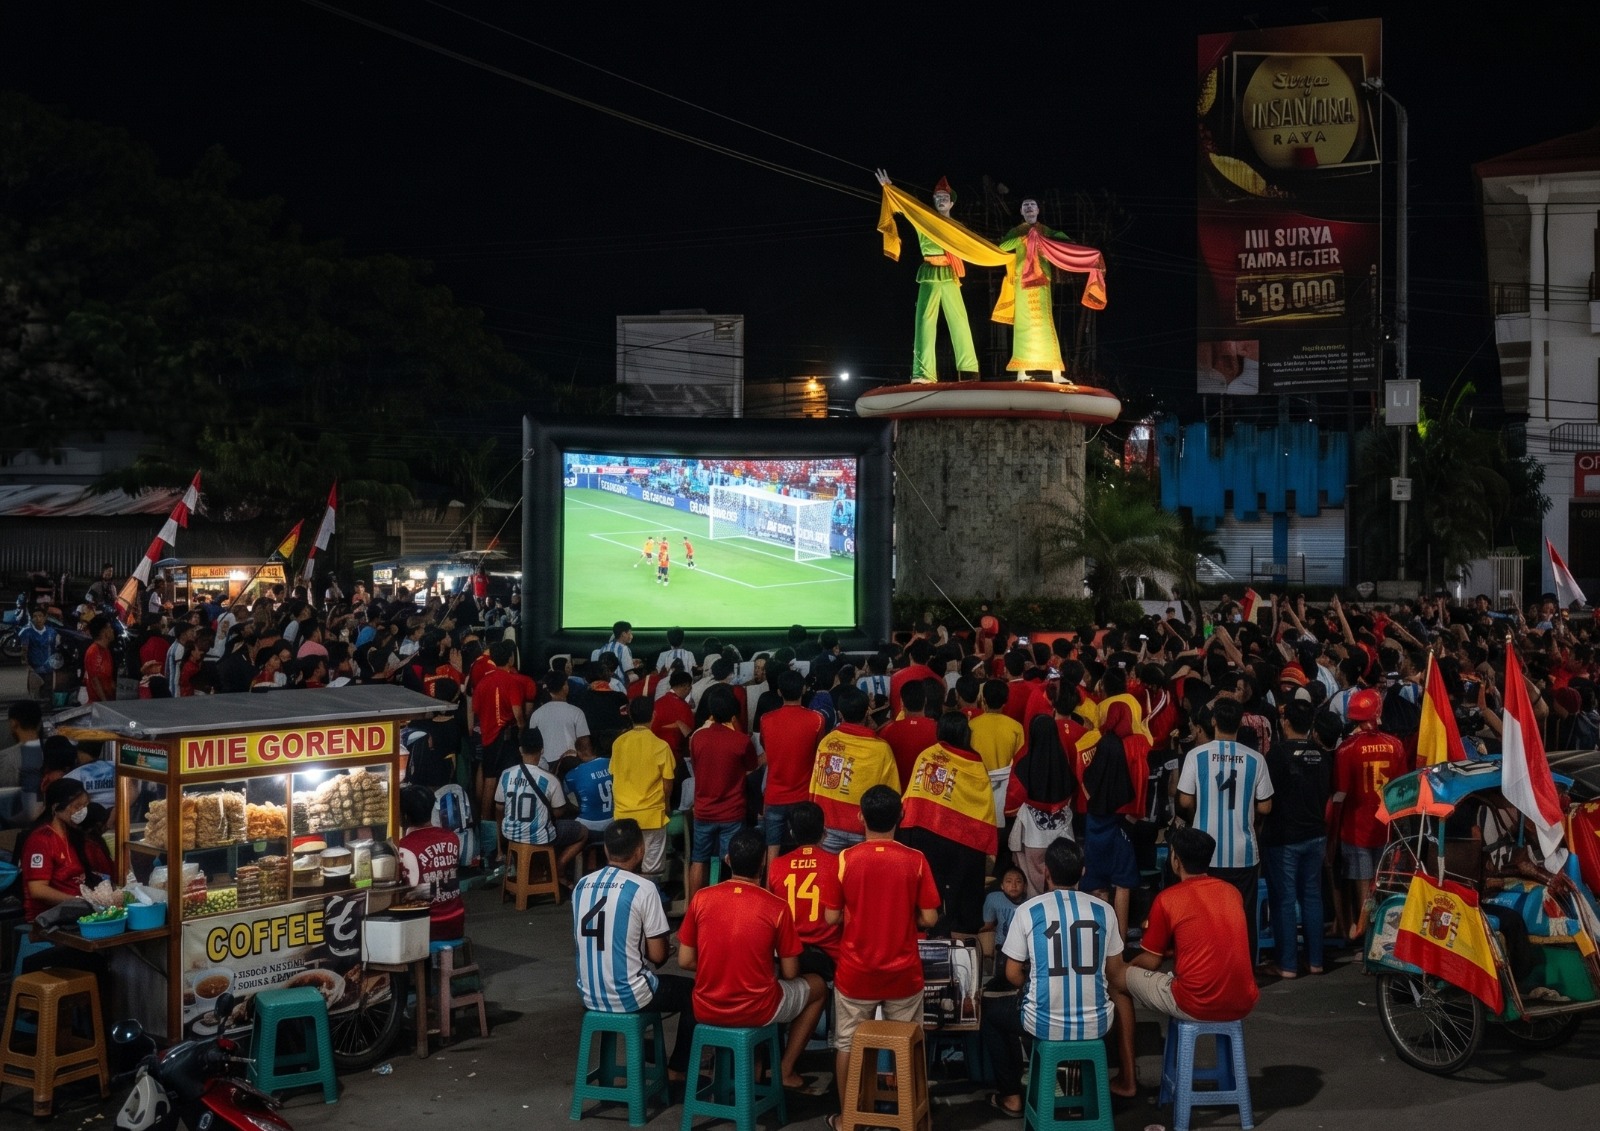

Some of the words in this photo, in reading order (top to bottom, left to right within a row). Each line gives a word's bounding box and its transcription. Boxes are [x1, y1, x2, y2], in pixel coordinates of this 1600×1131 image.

[1274, 131, 1326, 145] RAYA
[1274, 225, 1333, 247] SURYA
[1257, 278, 1336, 312] 18.000
[187, 737, 248, 769] MIE
[257, 725, 386, 762] GOREND
[506, 791, 537, 822] 10
[598, 780, 613, 813] 9
[783, 872, 820, 922] 14
[206, 910, 326, 962] COFFEE
[581, 895, 608, 951] 4
[1043, 919, 1101, 977] 10
